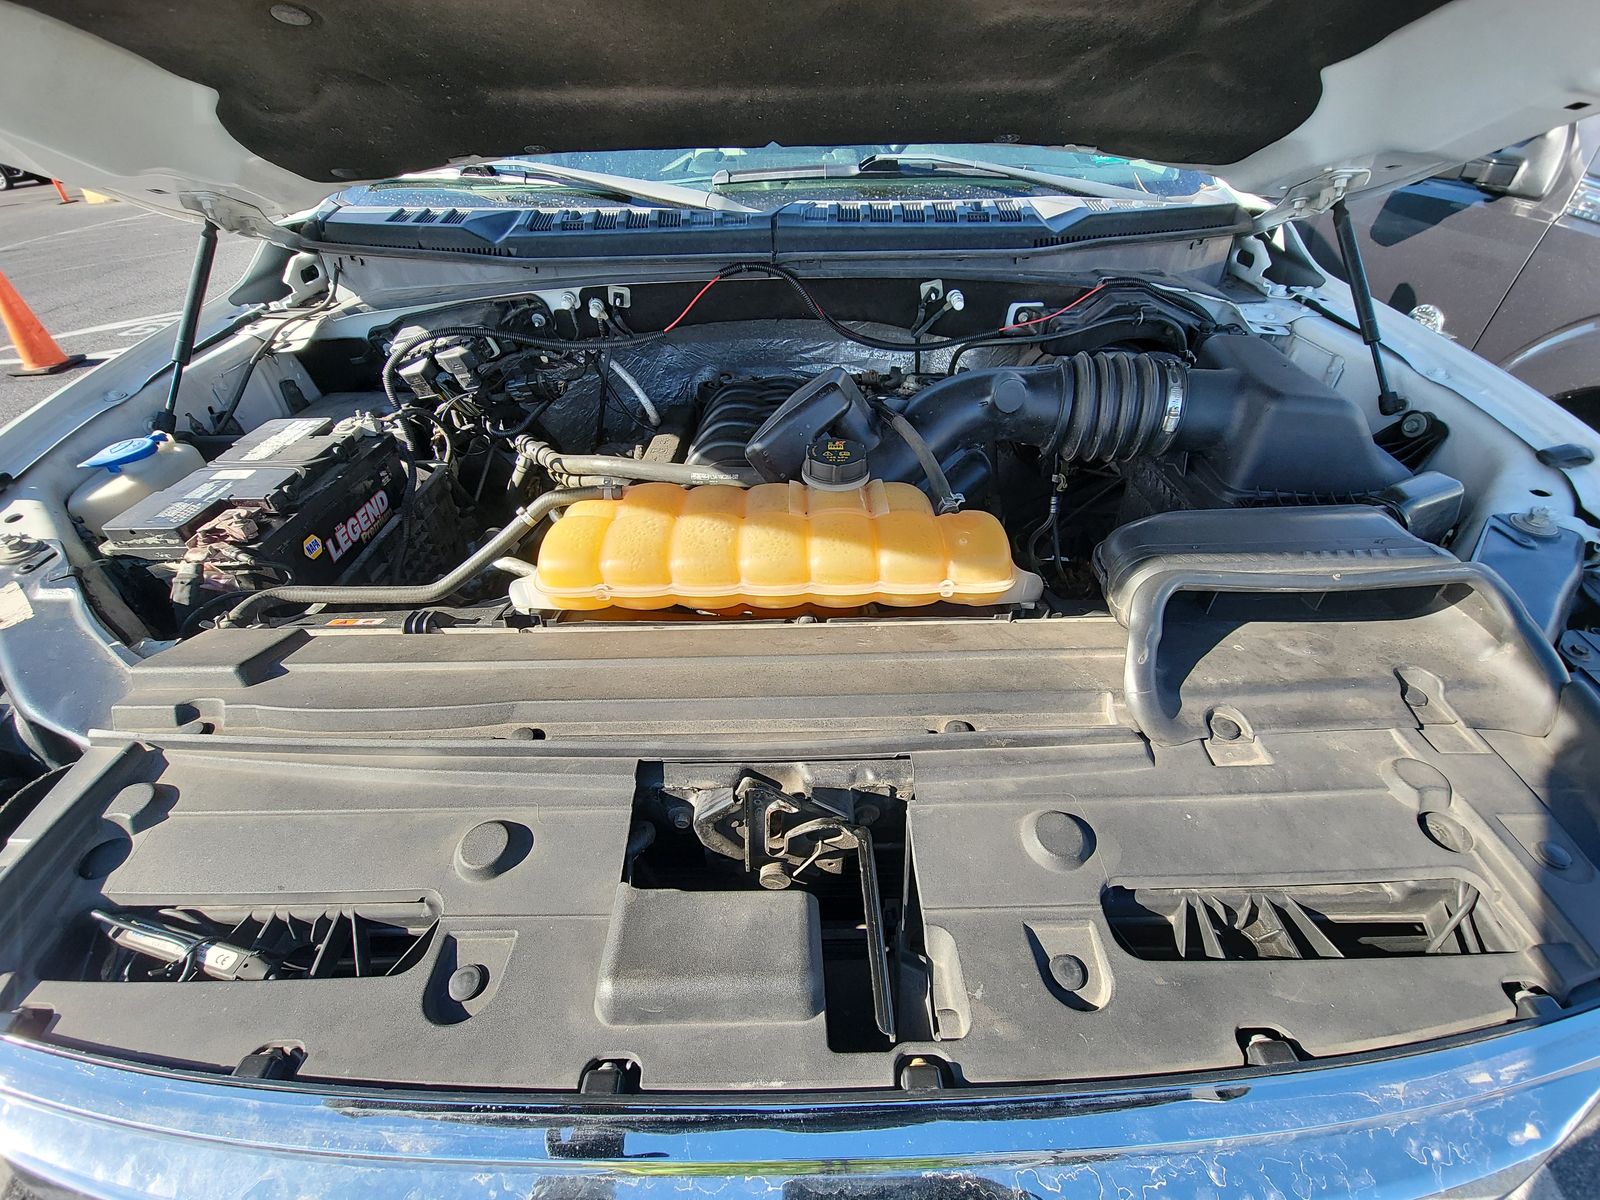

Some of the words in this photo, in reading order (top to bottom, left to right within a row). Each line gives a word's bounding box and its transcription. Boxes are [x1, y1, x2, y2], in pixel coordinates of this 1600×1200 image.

[326, 490, 388, 563] LEGEND
[361, 507, 393, 544] Premium
[306, 539, 321, 555] NAPA
